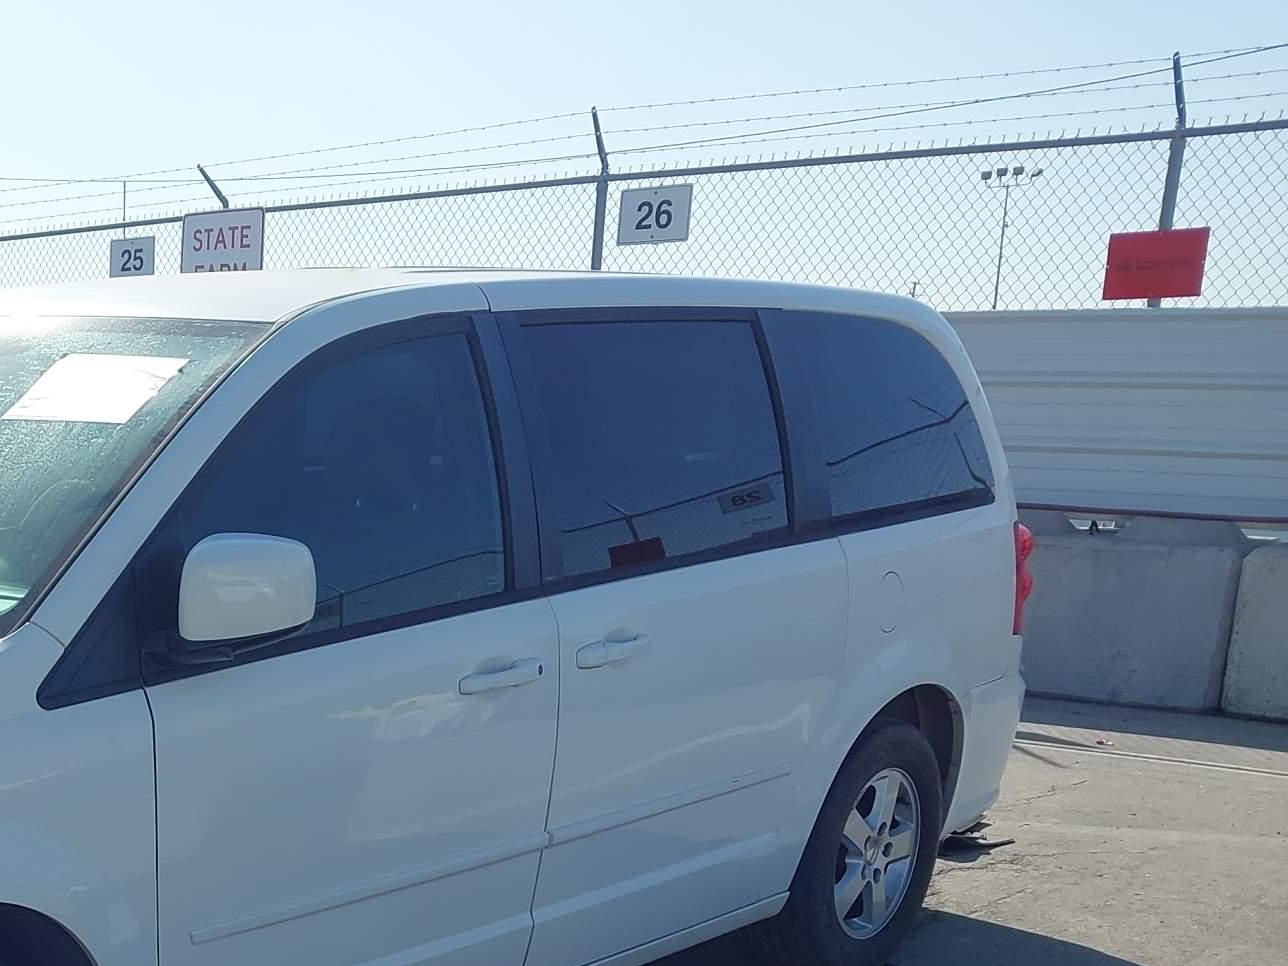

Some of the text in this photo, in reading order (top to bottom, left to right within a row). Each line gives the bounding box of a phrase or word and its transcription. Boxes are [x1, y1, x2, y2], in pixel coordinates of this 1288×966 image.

[635, 199, 673, 230] 26
[192, 225, 252, 252] STATE
[120, 248, 144, 272] 25
